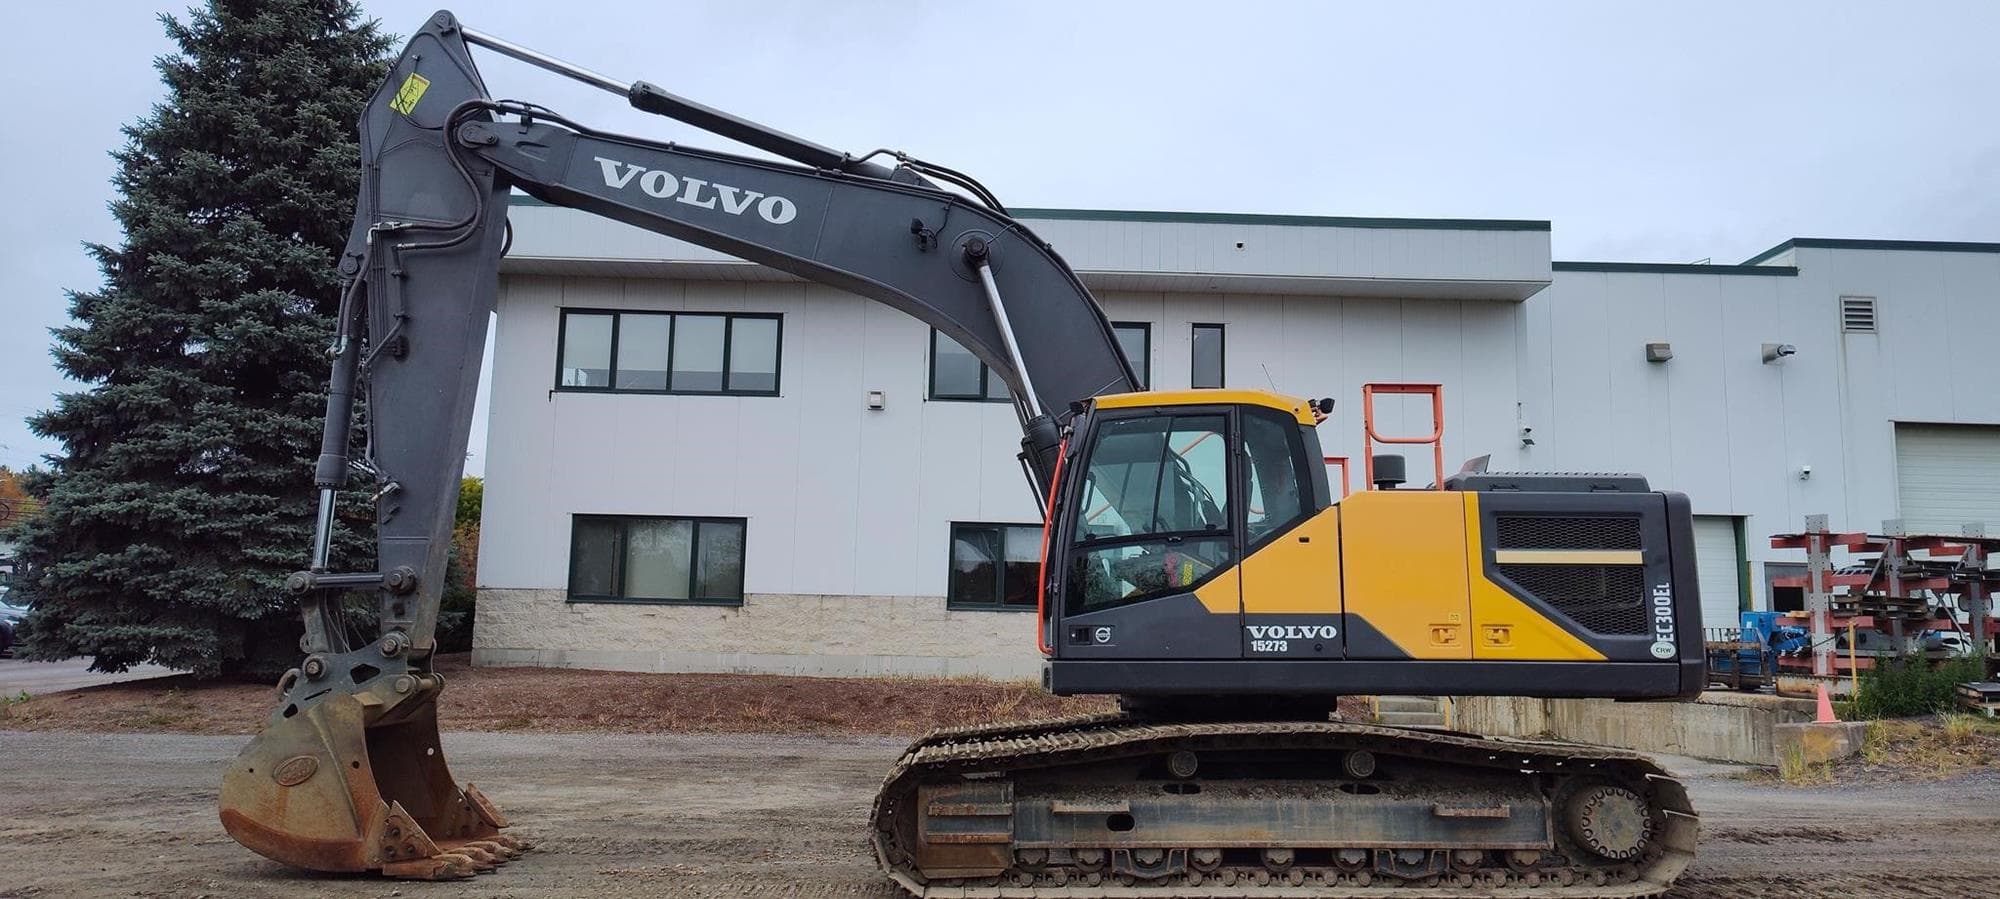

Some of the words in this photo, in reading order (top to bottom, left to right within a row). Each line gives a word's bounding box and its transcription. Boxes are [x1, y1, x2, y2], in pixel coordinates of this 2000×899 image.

[594, 156, 797, 225] VOLVO
[1246, 625, 1337, 639] VOLVO
[1251, 640, 1288, 652] 15273
